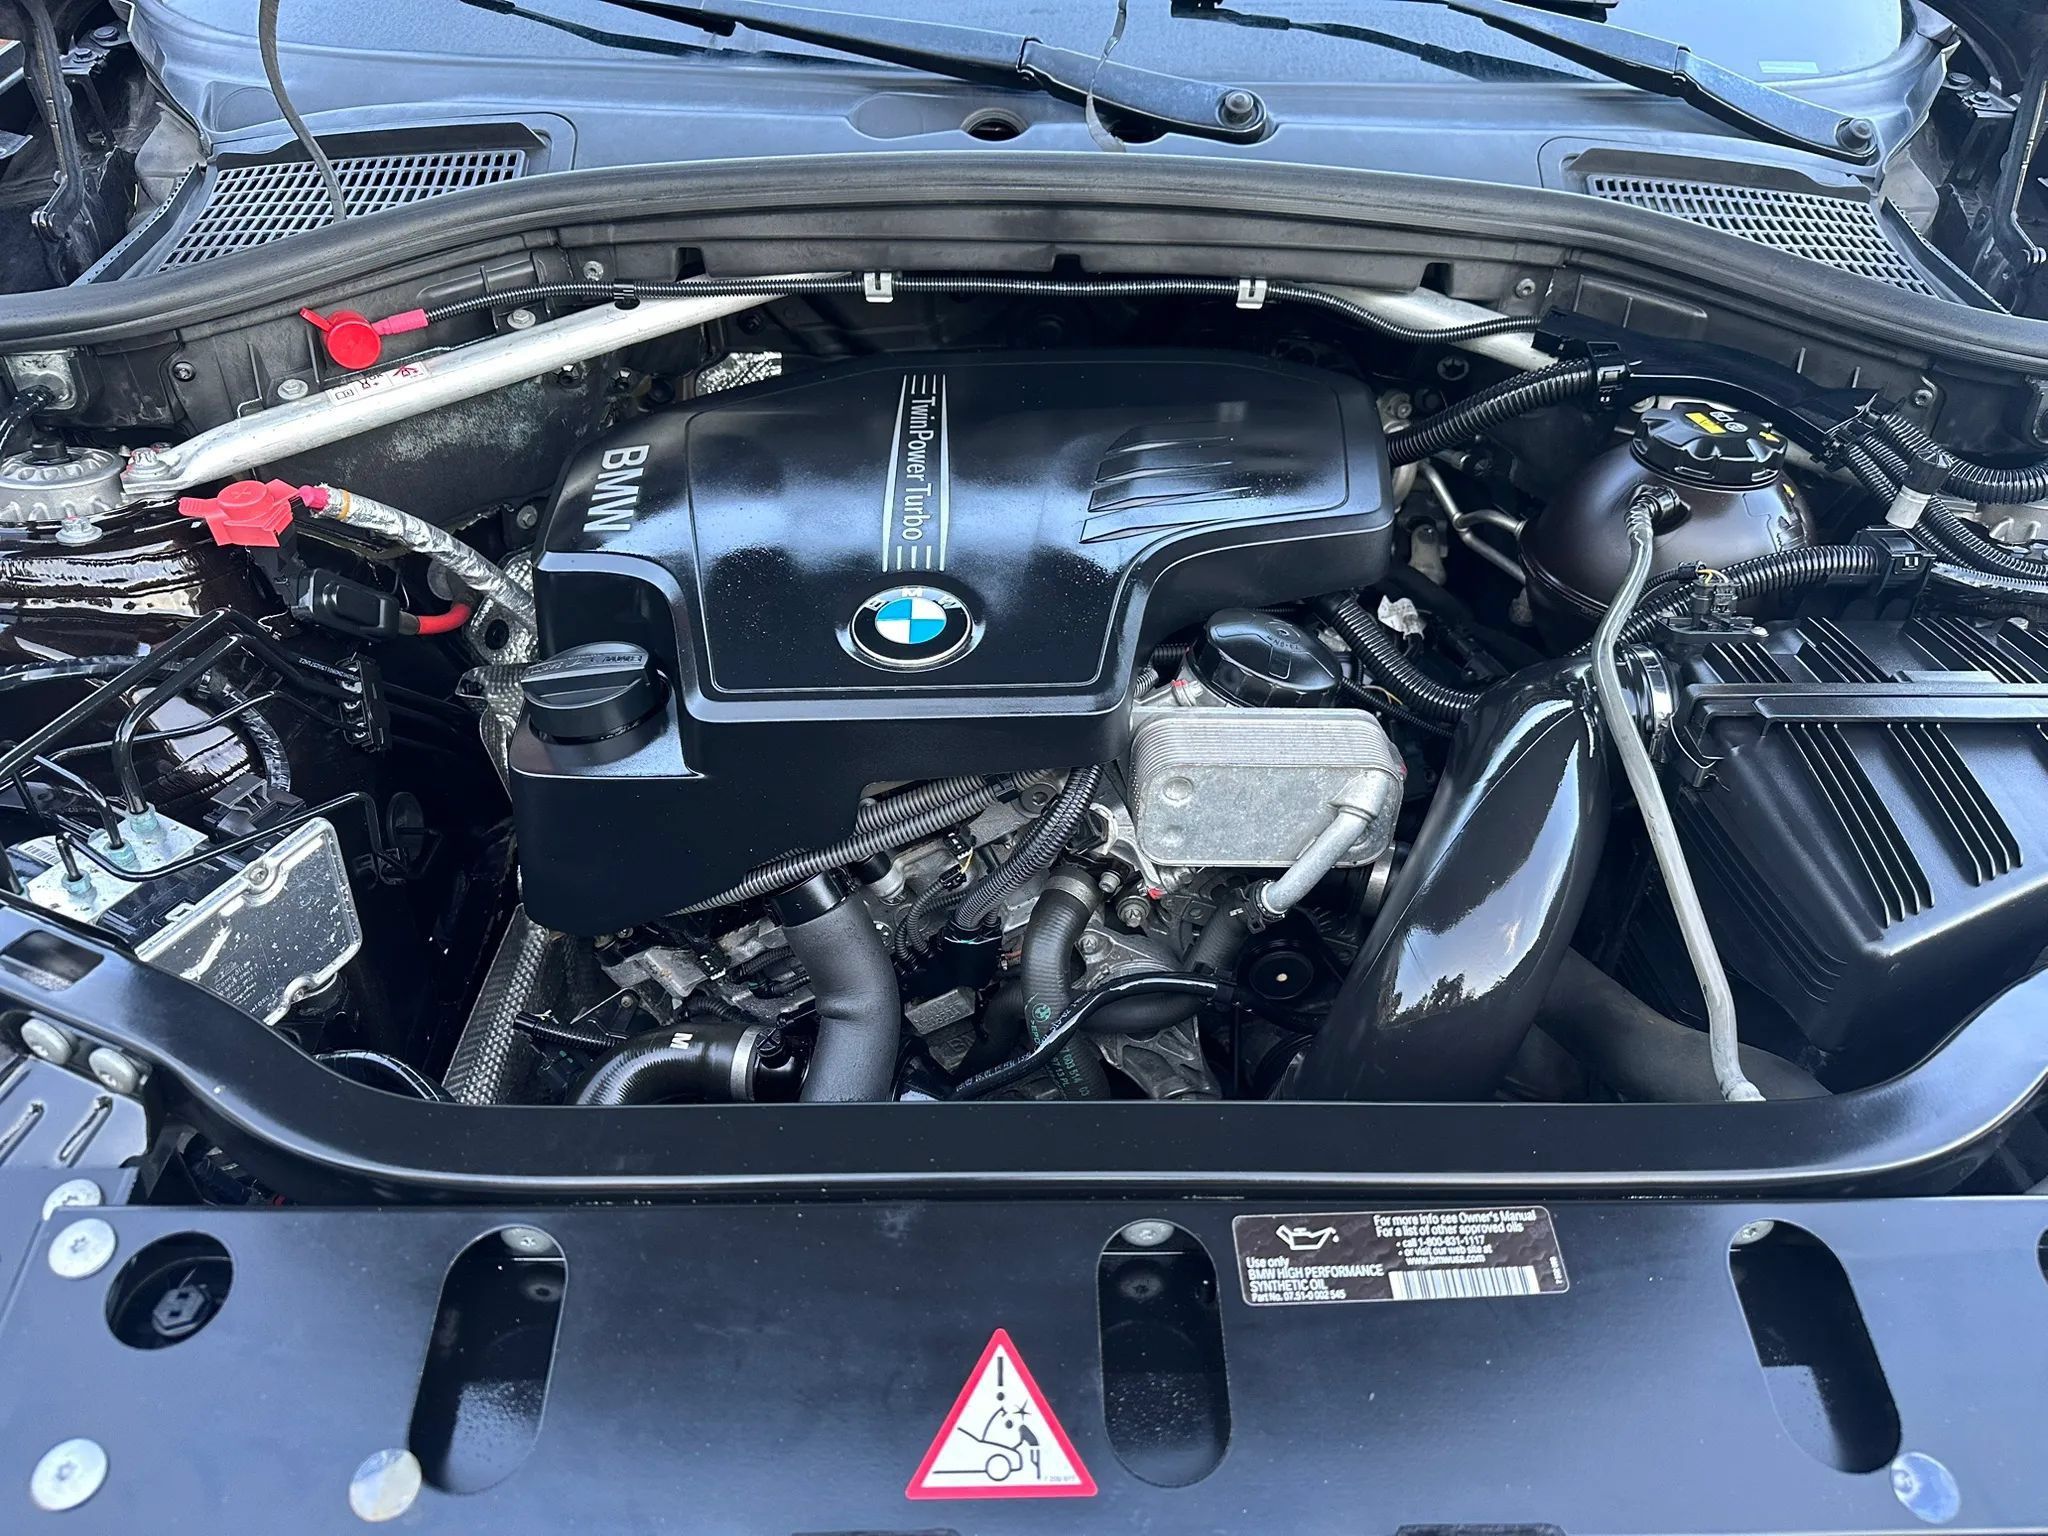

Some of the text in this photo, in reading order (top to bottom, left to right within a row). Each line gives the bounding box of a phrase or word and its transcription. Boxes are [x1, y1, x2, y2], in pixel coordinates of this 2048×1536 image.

[902, 396, 936, 541] TwinPower Turbo
[583, 445, 650, 532] BMW
[863, 587, 961, 611] BMW
[1373, 1209, 1537, 1226] For more info see Owner's Manual
[1376, 1225, 1394, 1237] For
[1394, 1227, 1403, 1237] a
[1403, 1225, 1418, 1236] list
[1419, 1224, 1430, 1236] of
[1431, 1224, 1458, 1236] other
[1459, 1221, 1505, 1236] approved
[1506, 1221, 1524, 1232] oils
[1402, 1237, 1418, 1248] call
[1404, 1247, 1415, 1257] or
[1415, 1246, 1432, 1256] visit
[1433, 1247, 1447, 1256] our
[1448, 1245, 1466, 1255] web
[1246, 1255, 1290, 1270] Use only
[1405, 1254, 1486, 1265] www.bmwusa.com
[1248, 1264, 1385, 1280] BMW HIGH PERFORMANCE
[1249, 1279, 1329, 1292] SYNTHETIC OIL
[1251, 1291, 1269, 1302] Part
[1269, 1291, 1283, 1302] No.
